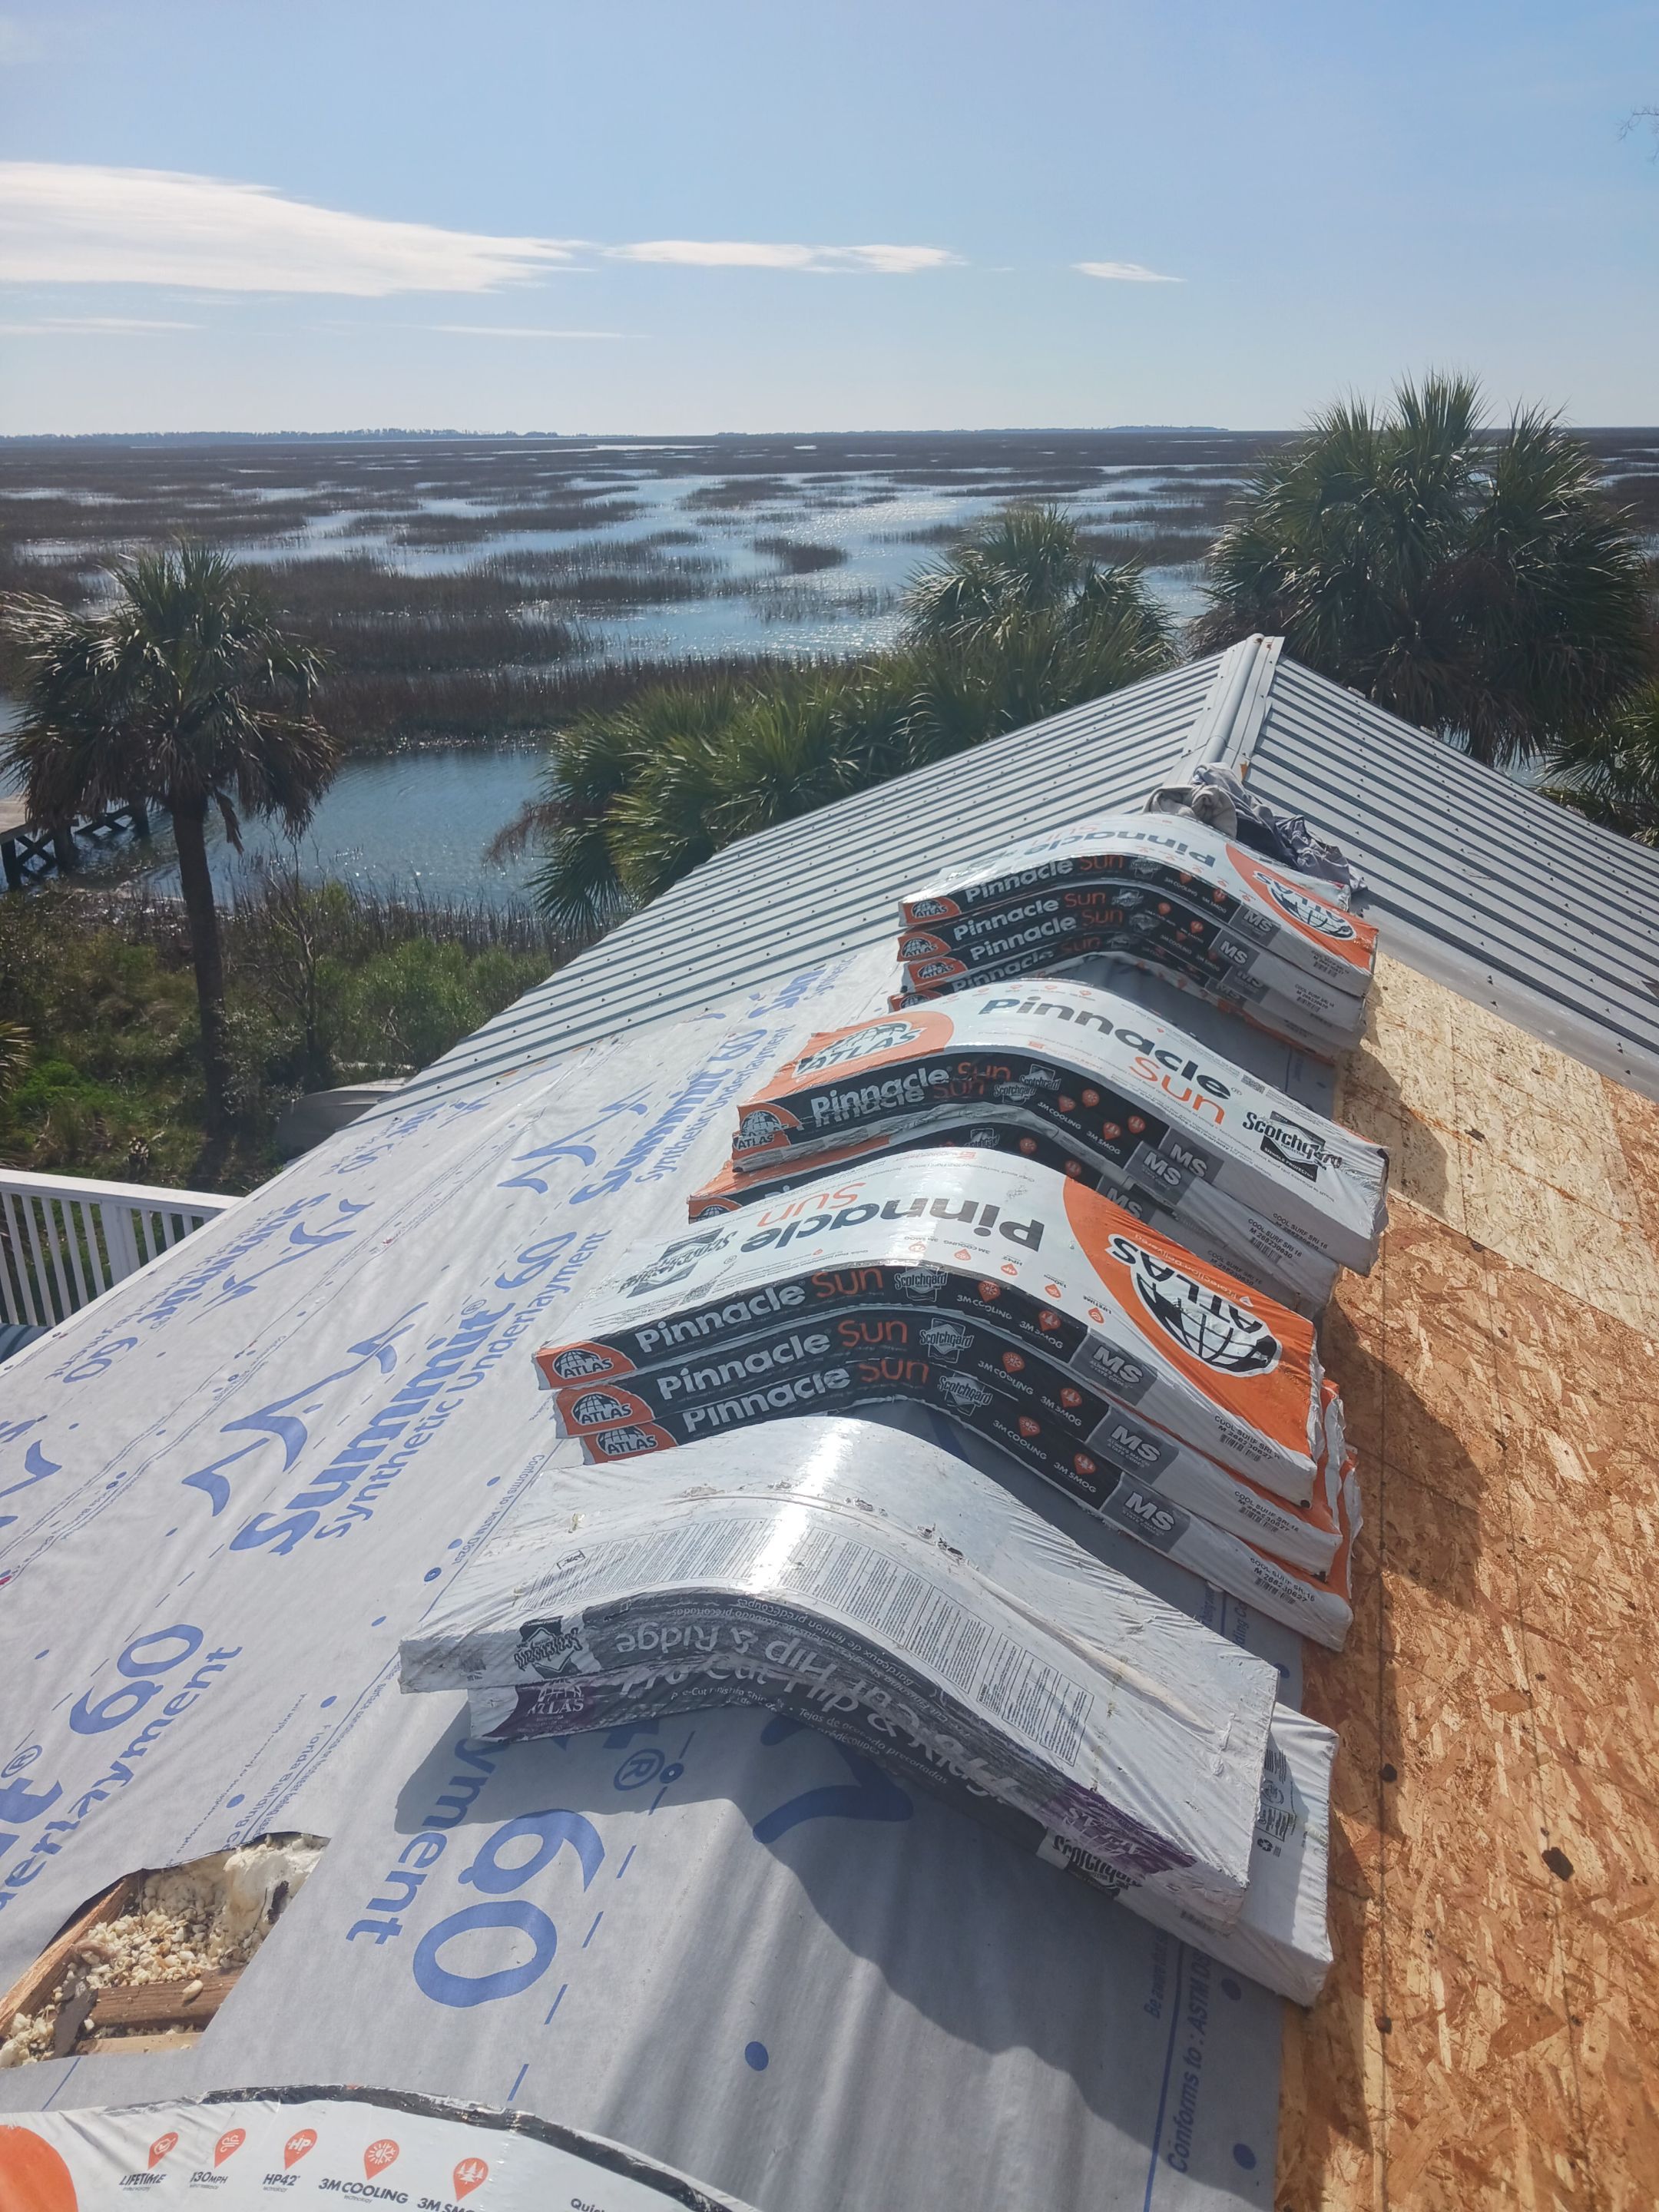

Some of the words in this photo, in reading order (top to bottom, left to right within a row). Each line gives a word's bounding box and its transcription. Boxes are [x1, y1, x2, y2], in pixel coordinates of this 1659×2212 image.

[1024, 830, 1217, 868] Pinnacle
[965, 859, 1074, 903] Pinnacle
[1080, 854, 1126, 871] Sun
[916, 906, 948, 919] ATLAS
[954, 899, 1060, 942] Pinnacle
[1064, 892, 1107, 908] Sun
[1243, 909, 1273, 932] MS
[969, 916, 1077, 962] Pinnacle
[1081, 908, 1123, 927] Sun
[1220, 940, 1248, 965] MS
[923, 965, 954, 979] ATLAS
[952, 950, 1055, 993] Pinnacle
[706, 1028, 767, 1063] 60
[808, 1029, 919, 1071] ATLAS
[978, 998, 1232, 1102] Pinnacle
[634, 1112, 718, 1184] Synthetic
[700, 1023, 797, 1116] Underlayment
[1129, 1055, 1226, 1125] Sun
[1037, 1101, 1049, 1111] 3M
[1048, 1108, 1082, 1131] COOLING
[737, 1134, 774, 1151] ATLAS
[1085, 1130, 1098, 1142] 3M
[1098, 1138, 1121, 1155] SMOG
[1168, 1142, 1208, 1178] MS
[1143, 1151, 1183, 1187] MS
[757, 1182, 867, 1227] Sun
[1106, 1187, 1143, 1219] MS
[740, 1197, 1045, 1253] Pinnacle
[1248, 1217, 1265, 1230] COOL
[1263, 1227, 1283, 1245] SURF
[1282, 1240, 1296, 1252] SRI
[1294, 1249, 1303, 1258] 16
[1249, 1227, 1258, 1236] M
[1273, 1211, 1290, 1225] COOL
[1288, 1220, 1309, 1236] SURF
[1307, 1233, 1320, 1243] SRI
[1320, 1240, 1329, 1250] 16
[494, 1230, 578, 1290] 60
[943, 1239, 979, 1252] COOLING
[1002, 1255, 1023, 1267] HP42
[1207, 1250, 1224, 1263] COOL
[894, 1271, 949, 1290] Scotchgard
[1111, 1237, 1264, 1335] ATLAS
[634, 1284, 806, 1353] Pinnacle
[811, 1267, 883, 1298] Sun
[956, 1293, 973, 1305] 3M
[972, 1298, 1013, 1321] COOLING
[1082, 1294, 1113, 1315] LIFETIME
[919, 1329, 975, 1349] Scotchgard
[1018, 1320, 1035, 1333] 3M
[1033, 1329, 1065, 1349] SMOG
[61, 1336, 138, 1385] 60
[564, 1358, 614, 1379] ATLAS
[657, 1333, 831, 1400] Pinnacle
[837, 1319, 908, 1347] Sun
[1092, 1345, 1144, 1383] MS
[313, 1395, 466, 1540] Synthetic
[457, 1229, 614, 1390] Underlayment
[937, 1375, 994, 1407] Scotchgard
[977, 1359, 995, 1374] 3M
[994, 1368, 1034, 1396] COOLING
[682, 1367, 851, 1434] Pinnacle
[857, 1357, 930, 1384] Sun
[1039, 1395, 1055, 1409] 3M
[1053, 1405, 1082, 1427] SMOG
[581, 1403, 631, 1425] ATLAS
[1217, 1425, 1227, 1433] M
[607, 1435, 657, 1455] ATLAS
[992, 1419, 1007, 1433] 3M
[1005, 1428, 1048, 1460] COOLING
[1111, 1424, 1162, 1462] MS
[1214, 1415, 1235, 1433] COOL
[1258, 1442, 1273, 1455] SRI
[506, 1454, 546, 1496] Conforms
[1053, 1462, 1070, 1475] 3M
[1068, 1471, 1098, 1494] SMOG
[1124, 1490, 1177, 1532] MS
[1234, 1490, 1253, 1508] COOL
[1253, 1567, 1263, 1575] M
[1305, 1593, 1316, 1602] 16
[615, 1624, 723, 1654] Ridge
[730, 1626, 758, 1655] &
[69, 1624, 205, 1736] 60
[763, 1637, 840, 1691] Hip
[861, 1647, 914, 1688] Bardeaux
[797, 1704, 825, 1727] Tejas
[412, 1808, 606, 2009] 60
[1186, 1978, 1214, 2035] ASTM
[1181, 2044, 1204, 2071] to
[1167, 2070, 1200, 2174] Conforms
[118, 2173, 167, 2186] LIFETIME
[189, 2171, 229, 2184] 130MPH
[319, 2177, 342, 2192] 3M
[341, 2181, 409, 2205] COOLING
[417, 2197, 442, 2212] 3M
